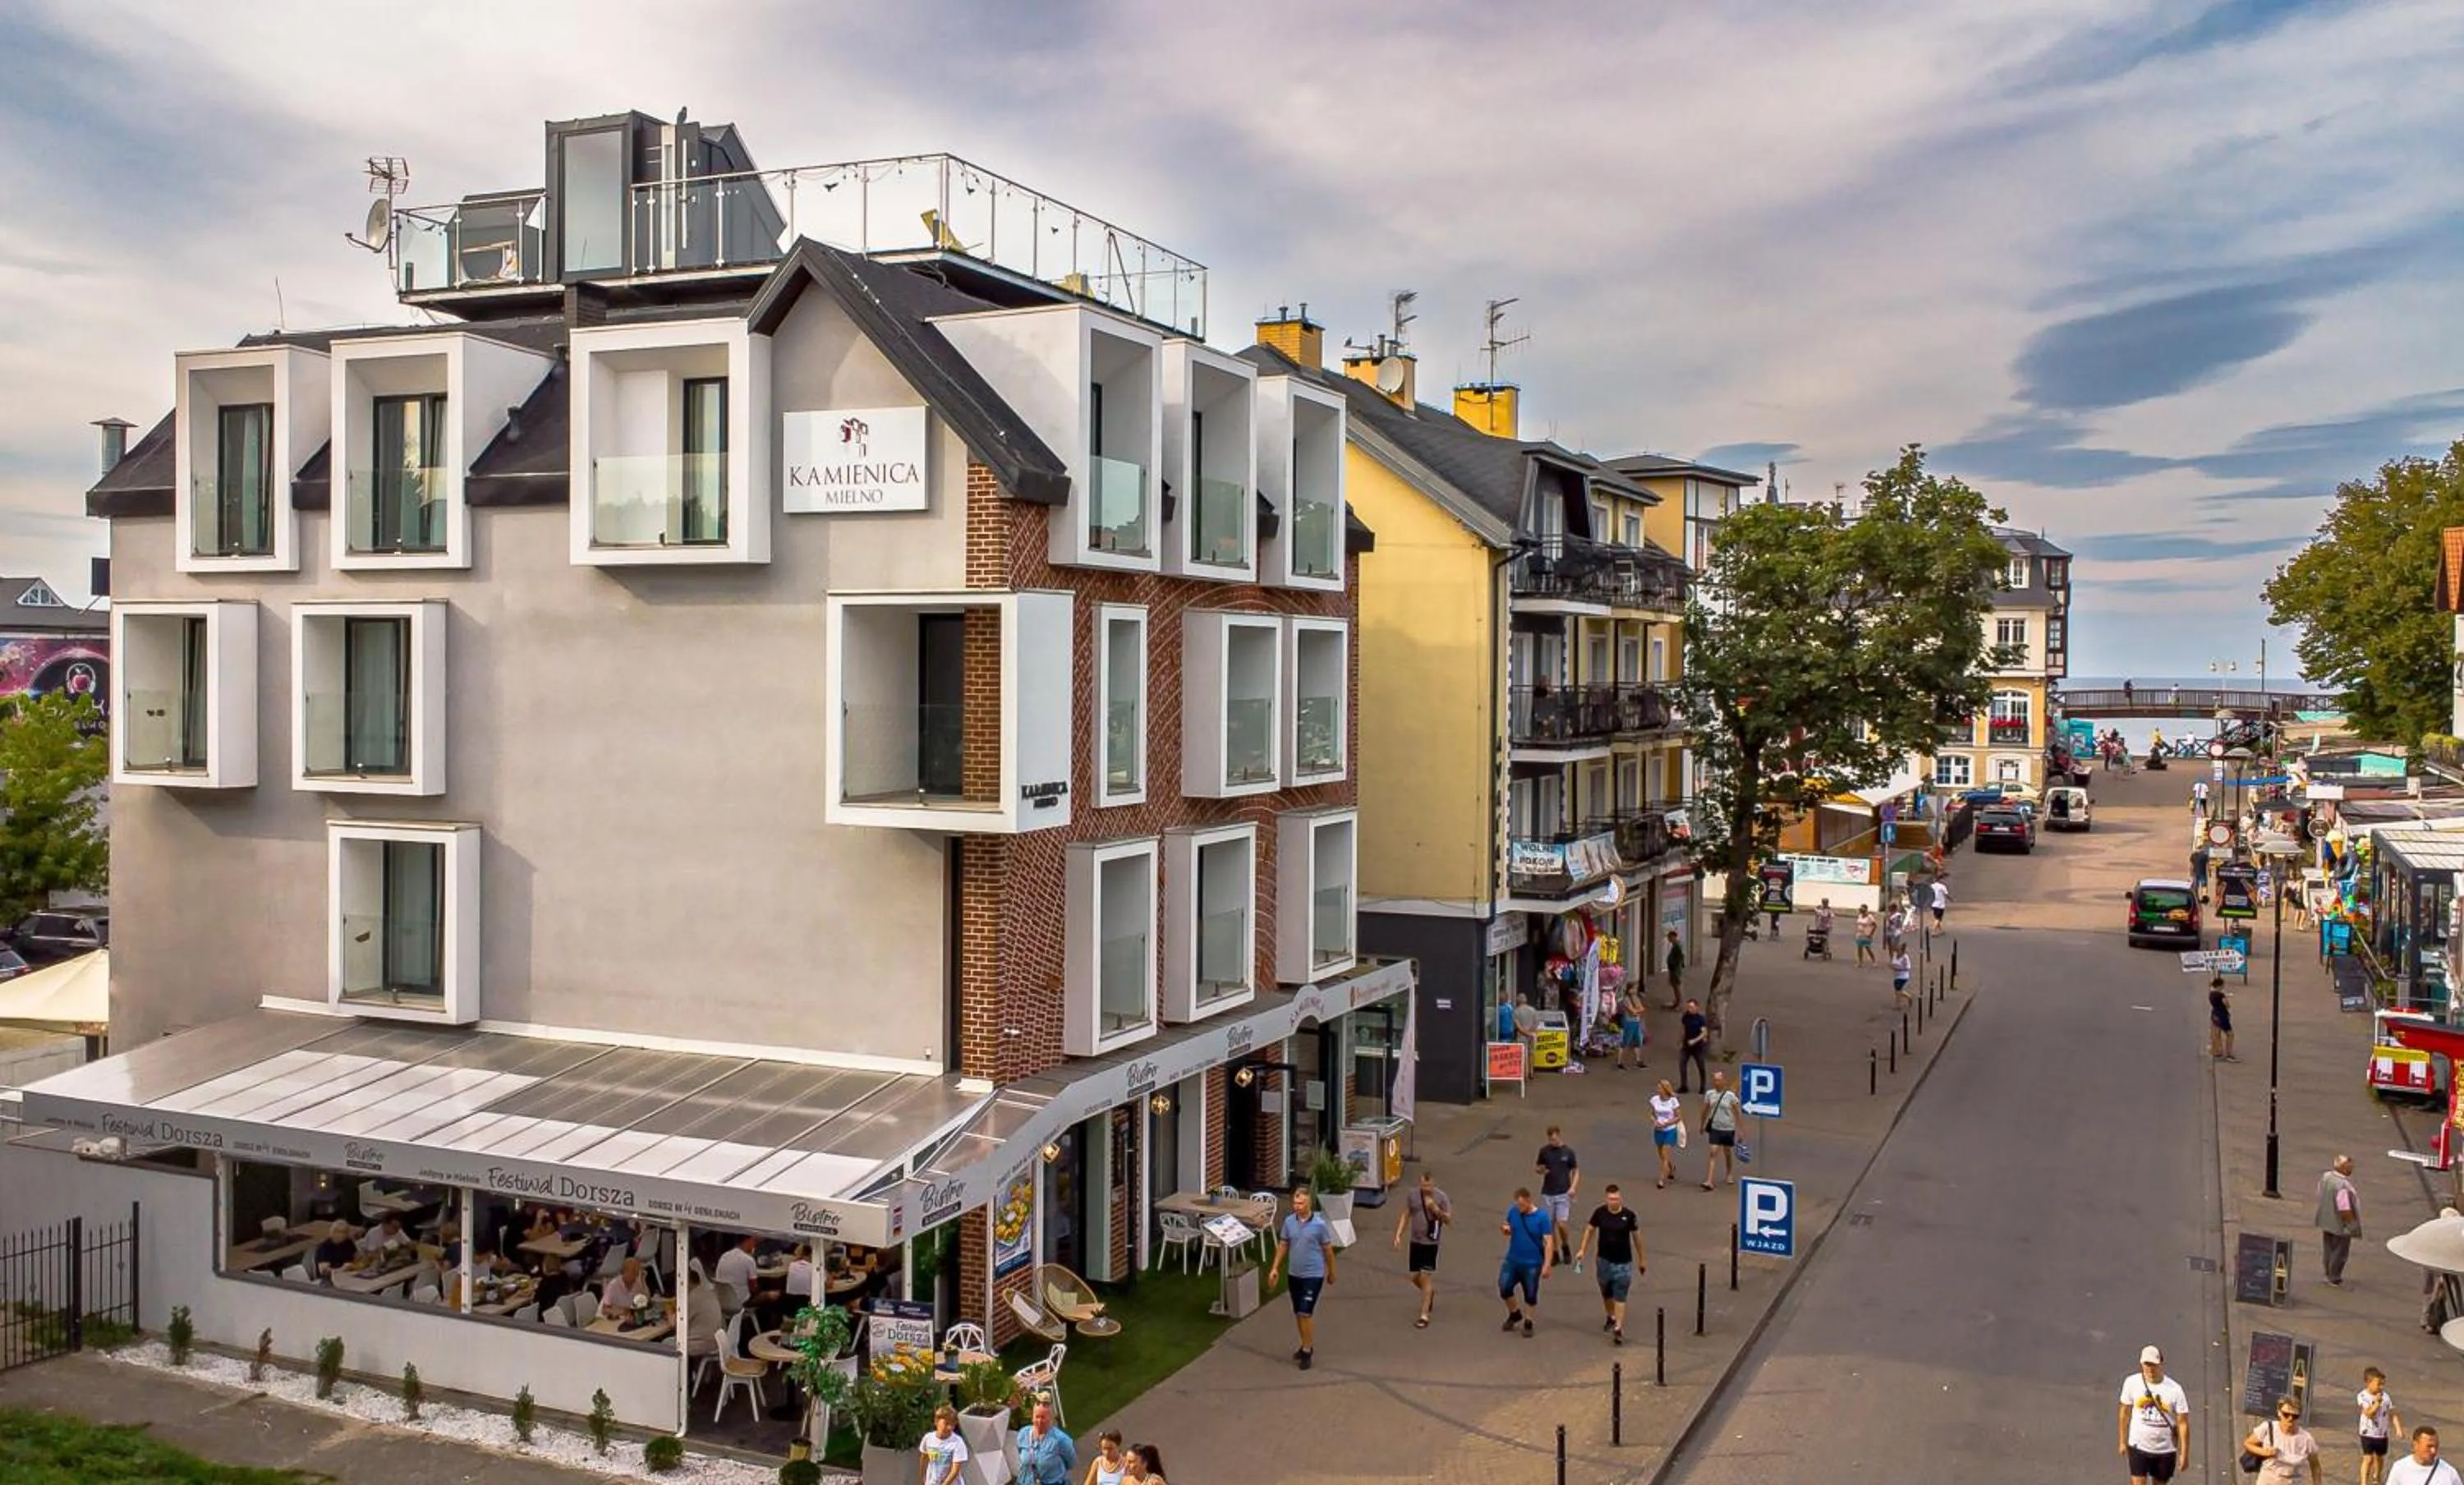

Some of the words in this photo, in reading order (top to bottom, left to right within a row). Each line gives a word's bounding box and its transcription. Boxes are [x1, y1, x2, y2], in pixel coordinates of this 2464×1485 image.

[789, 462, 919, 486] KAMIENICA
[825, 488, 884, 504] MIELNO
[1127, 1060, 1159, 1087] Bistro
[1750, 1069, 1774, 1101] P
[102, 1113, 156, 1139] Festiwal
[161, 1123, 223, 1147] Dorsza
[488, 1166, 554, 1195] Festiwal
[560, 1176, 635, 1207] Dorsza
[920, 1179, 966, 1213] Bistro
[791, 1202, 844, 1225] Bistro
[1746, 1183, 1788, 1234] P
[1745, 1239, 1786, 1251] WJAZD
